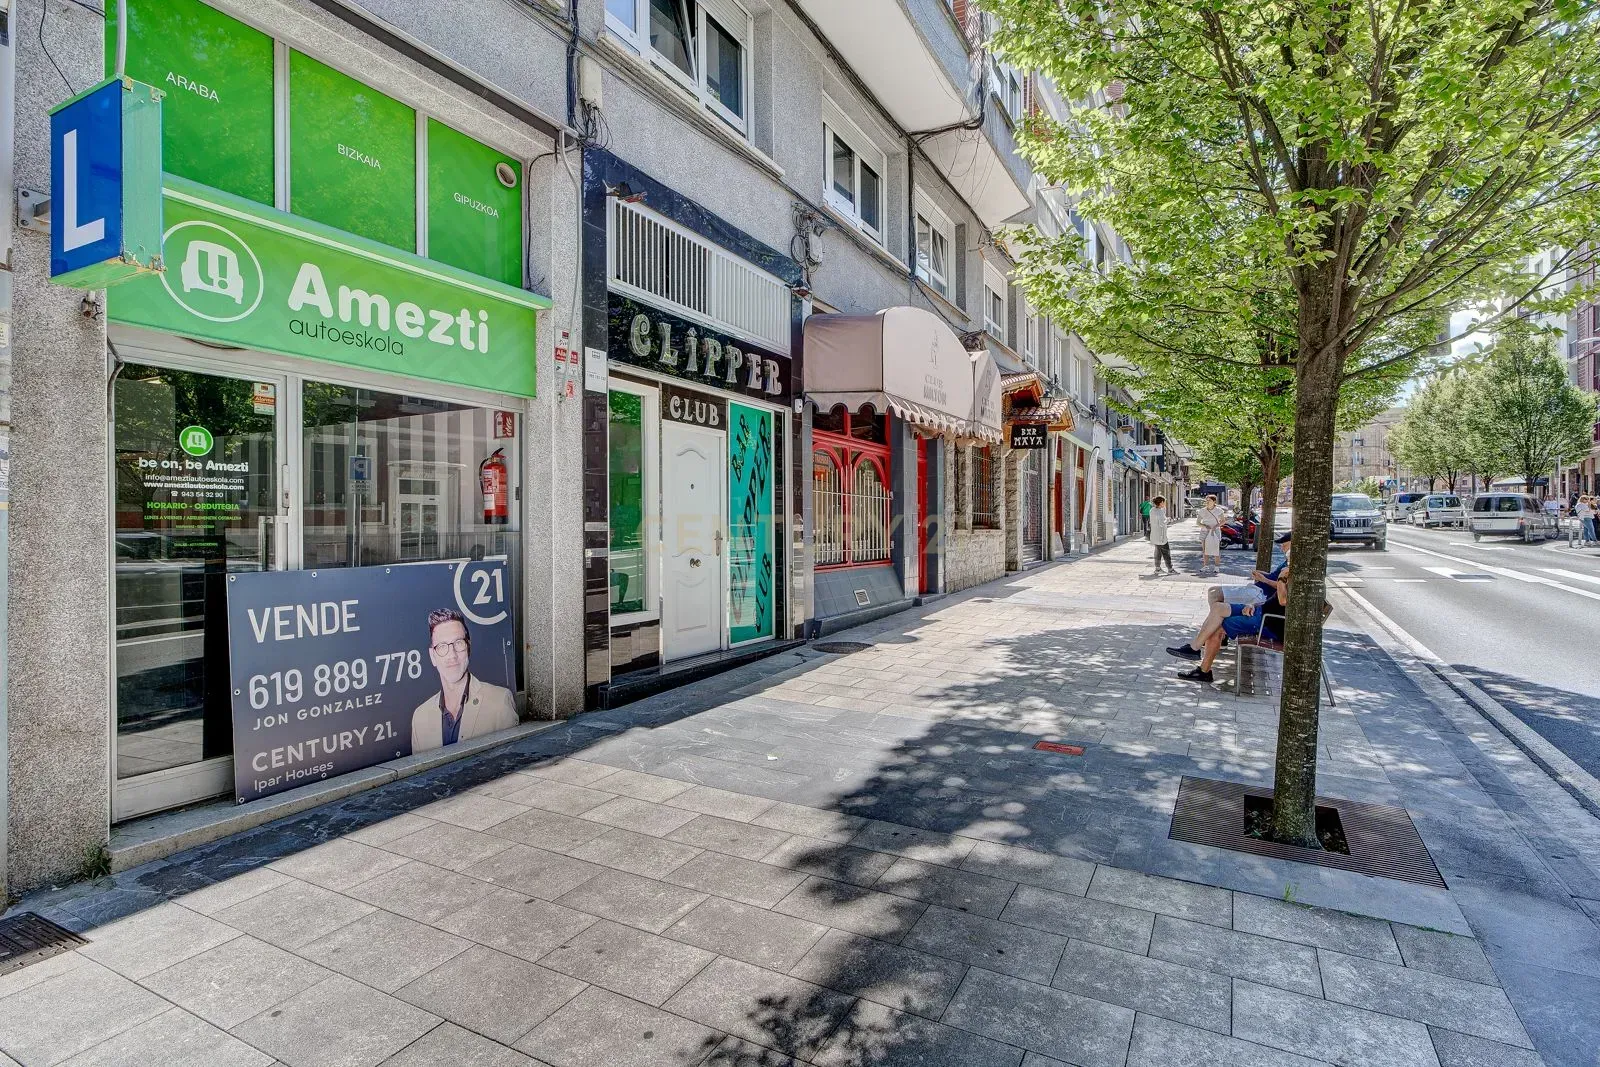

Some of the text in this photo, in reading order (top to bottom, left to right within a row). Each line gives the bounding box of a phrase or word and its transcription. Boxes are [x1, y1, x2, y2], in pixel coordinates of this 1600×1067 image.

[166, 71, 220, 103] ARABA
[337, 143, 382, 170] BIZKAIA
[63, 128, 105, 253] L
[454, 192, 499, 218] GIPUZKOA
[287, 262, 489, 354] Amezti
[288, 316, 404, 357] autoeskola
[669, 395, 720, 426] CLUB
[1013, 436, 1043, 447] MAYA
[1020, 427, 1037, 436] BAR
[731, 413, 750, 483] BAR
[138, 457, 249, 472] be on, be Amezti
[145, 474, 245, 484] info@ameztiautoeskola.com
[143, 481, 245, 491] www.ameztiautoeskola.com
[146, 501, 188, 509] HORARIO
[194, 502, 240, 510] ORDUTEGIA
[470, 568, 504, 606] 21
[755, 552, 771, 632] CLUB
[247, 599, 360, 644] VENDE
[248, 649, 422, 709] 619 889 778
[253, 693, 383, 731] JON GONZALEZ
[251, 726, 368, 772] CENTURY
[254, 760, 334, 792] Ipar Houses
